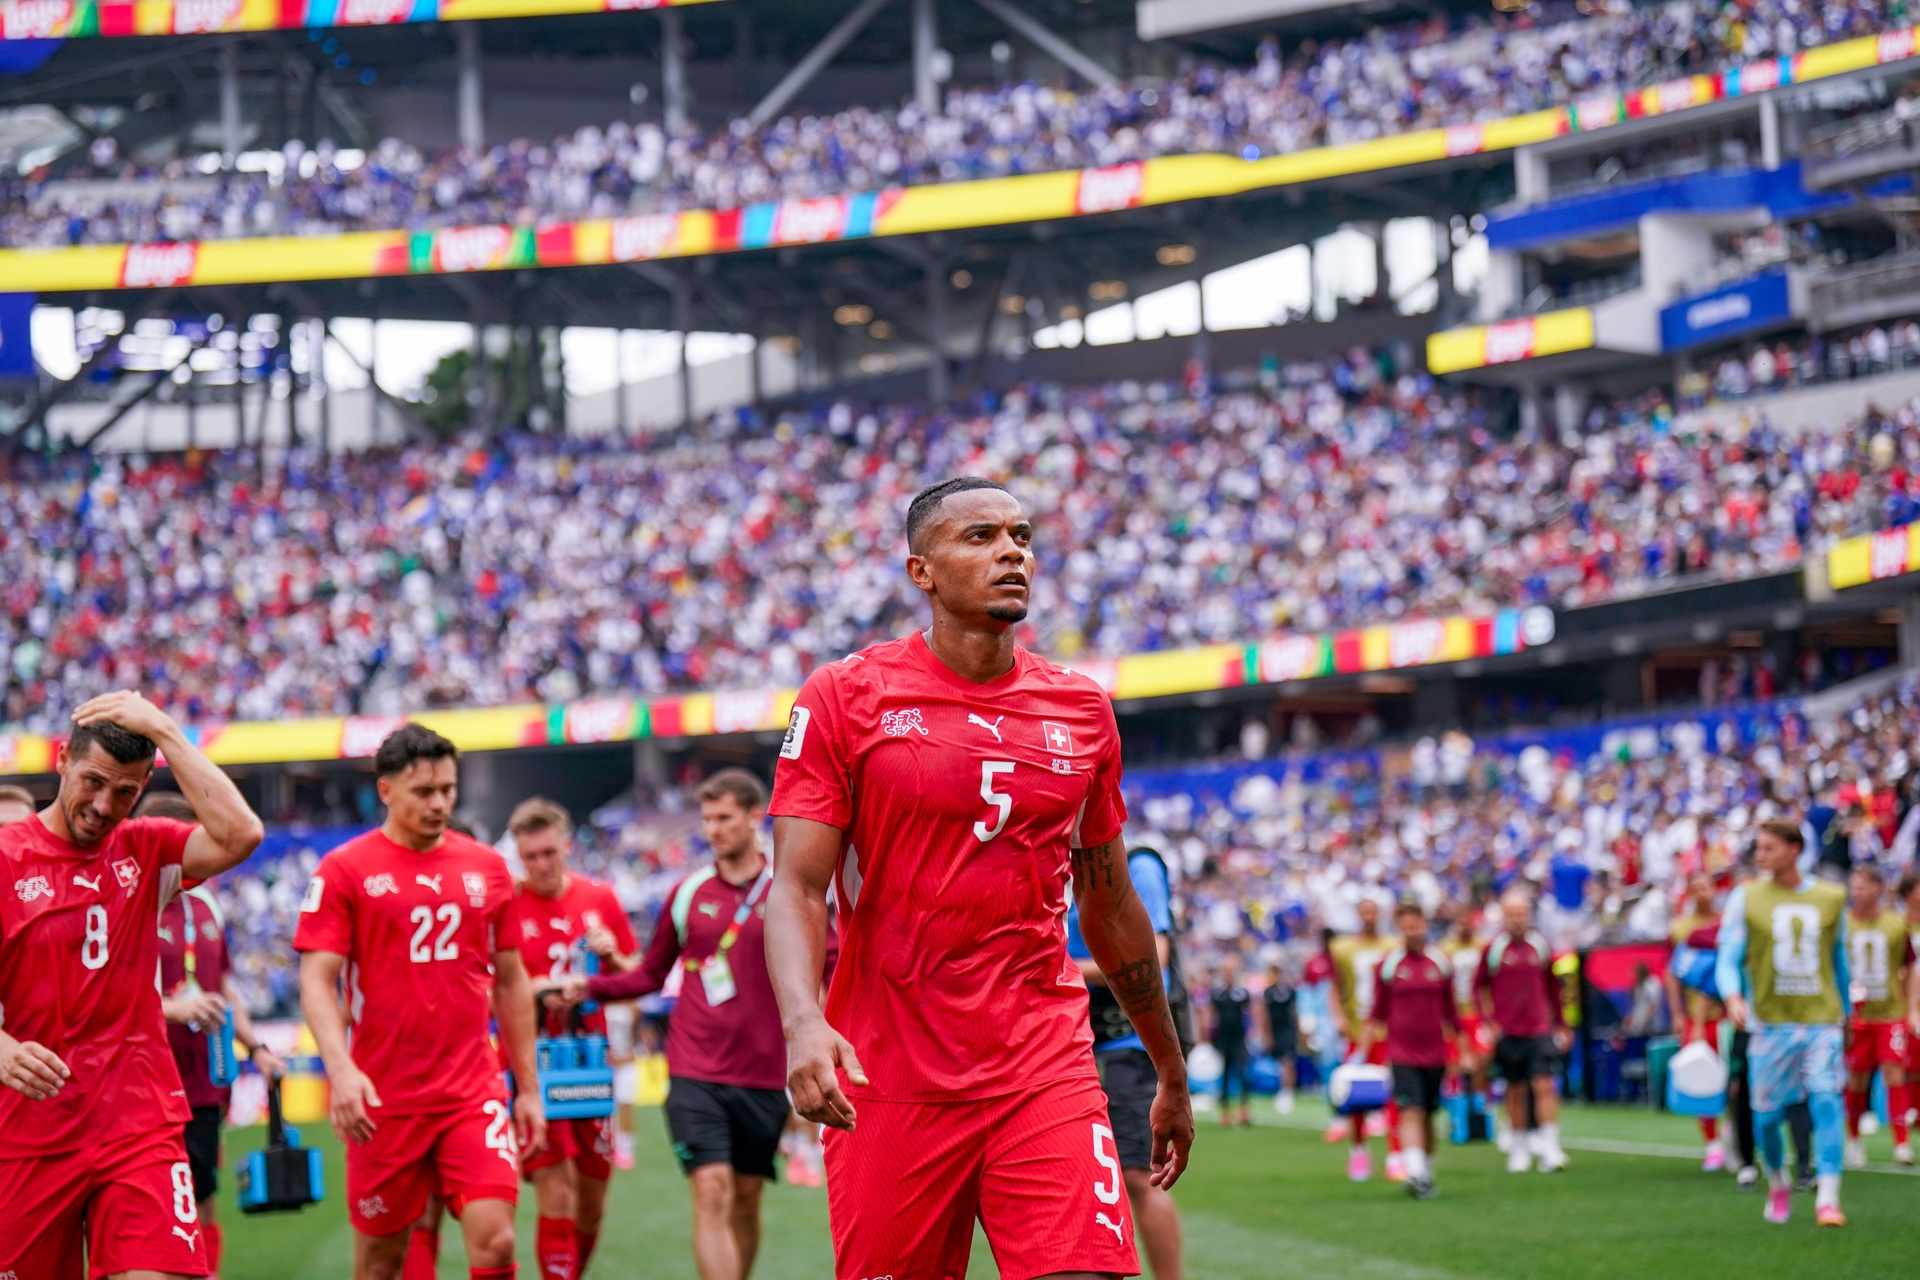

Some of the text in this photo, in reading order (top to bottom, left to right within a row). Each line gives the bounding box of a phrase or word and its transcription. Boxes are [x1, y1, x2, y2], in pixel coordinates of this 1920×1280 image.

[973, 761, 1016, 842] 5
[81, 904, 109, 970] 8
[410, 903, 462, 964] 22
[171, 1161, 198, 1224] 8
[1092, 1123, 1119, 1205] 5
